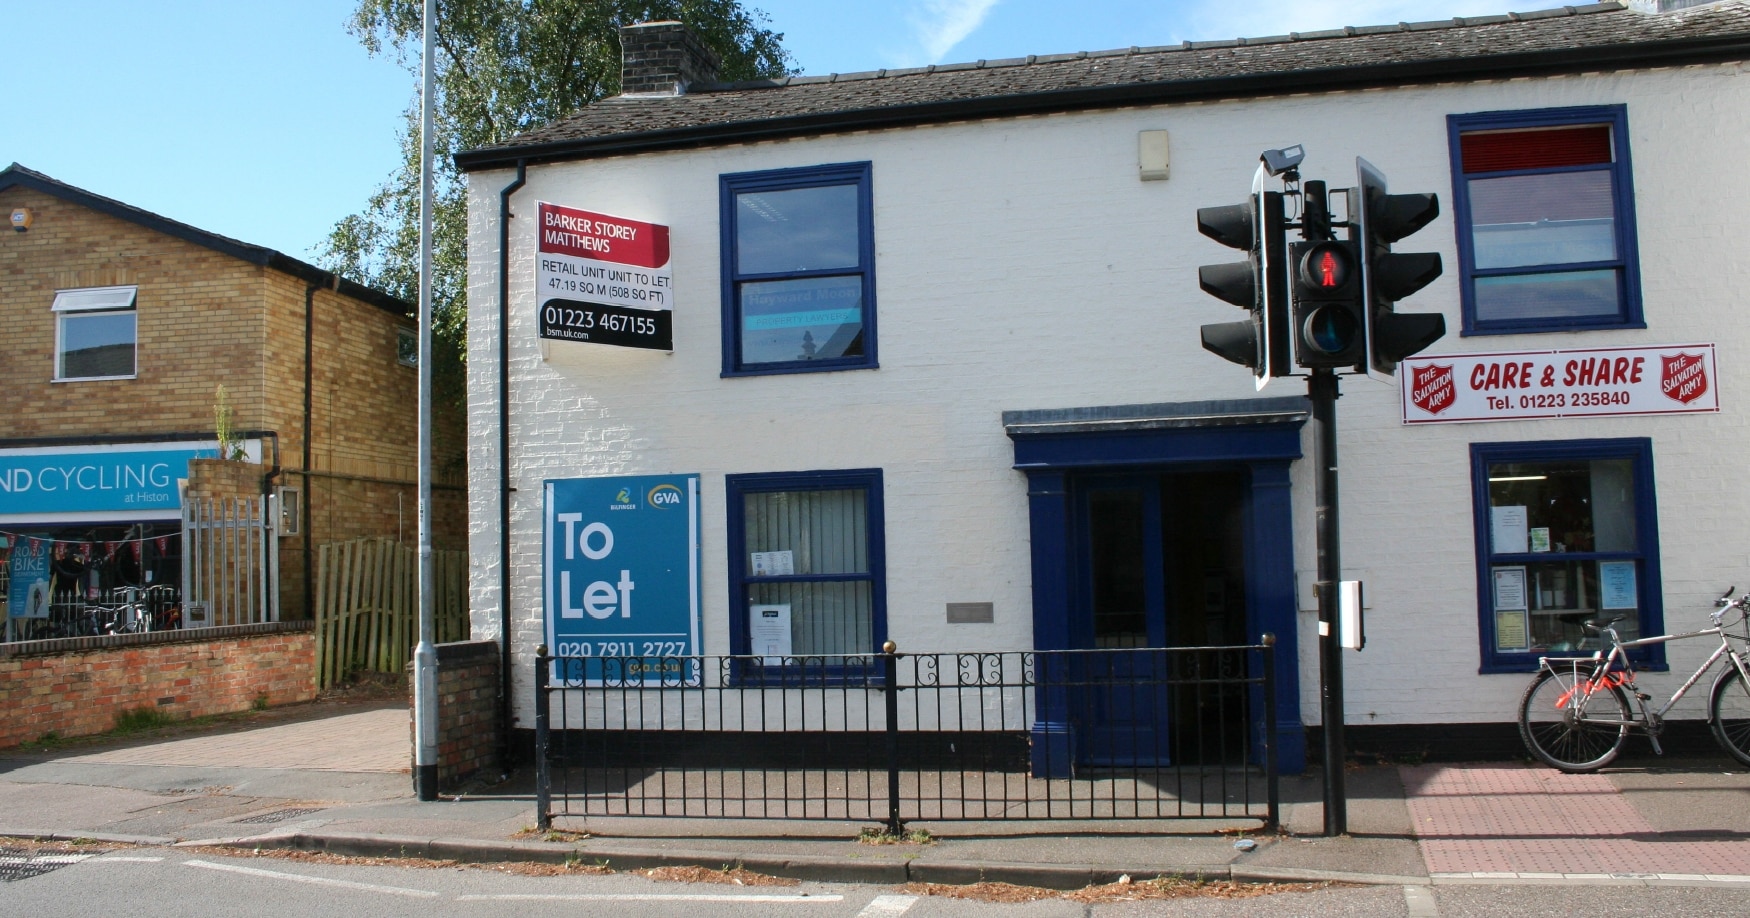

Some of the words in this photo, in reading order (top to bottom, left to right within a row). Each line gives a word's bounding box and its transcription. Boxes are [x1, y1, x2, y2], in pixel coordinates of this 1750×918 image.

[545, 212, 592, 234] BARKER
[594, 222, 637, 240] STOREY
[545, 230, 610, 253] MATTHEWS
[542, 260, 579, 276] RETAIL
[581, 266, 605, 279] UNIT
[608, 269, 632, 283] UNIT
[635, 274, 649, 285] TO
[549, 278, 576, 291] 47.19
[580, 282, 594, 295] SQ
[597, 285, 606, 295] M
[609, 286, 629, 299] (508
[632, 290, 646, 301] SQ
[650, 291, 664, 304] FT)
[546, 306, 594, 329] 01223
[599, 313, 656, 335] 467155
[756, 316, 803, 326] PROPERTY
[806, 312, 849, 322] LAWYERS
[546, 326, 589, 340] bsm.uk.com
[1418, 367, 1436, 385] THE
[1470, 362, 1534, 391] CARE
[1540, 364, 1555, 387] &
[1563, 357, 1645, 387] SHARE
[1663, 359, 1702, 392] SALVATION
[1668, 356, 1686, 374] THE
[1414, 369, 1452, 403] SALVATION
[1428, 385, 1451, 409] ARMY
[1678, 374, 1702, 399] ARMY
[1486, 395, 1514, 410] Tel.
[1520, 394, 1566, 409] 01223
[1571, 391, 1630, 407] 235840
[38, 463, 169, 491] CYCLING
[125, 493, 134, 502] at
[137, 492, 169, 502] Histon
[653, 492, 680, 504] GVA
[558, 512, 614, 560] To
[14, 558, 44, 571] BIKE
[561, 570, 634, 619] Let
[558, 642, 592, 657] 020
[598, 642, 634, 657] 7911
[643, 641, 686, 657] 2727
